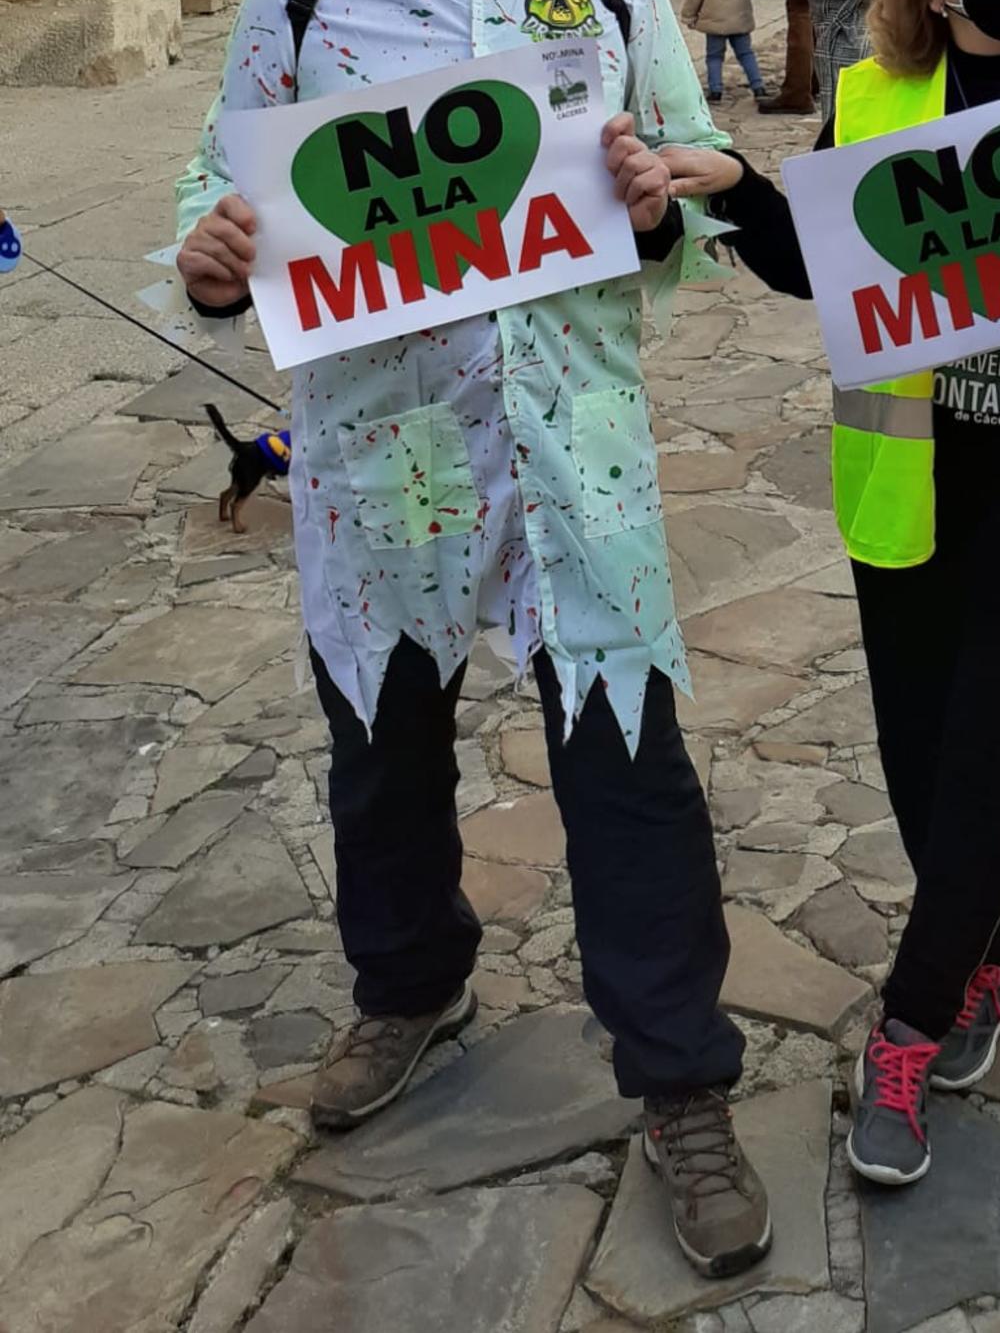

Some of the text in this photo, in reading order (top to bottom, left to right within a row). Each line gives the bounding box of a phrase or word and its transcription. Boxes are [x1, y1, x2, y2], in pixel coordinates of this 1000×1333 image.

[335, 89, 502, 192] NO
[364, 176, 478, 231] A LA
[287, 192, 594, 332] MINA
[919, 230, 950, 263] A
[954, 411, 970, 421] de
